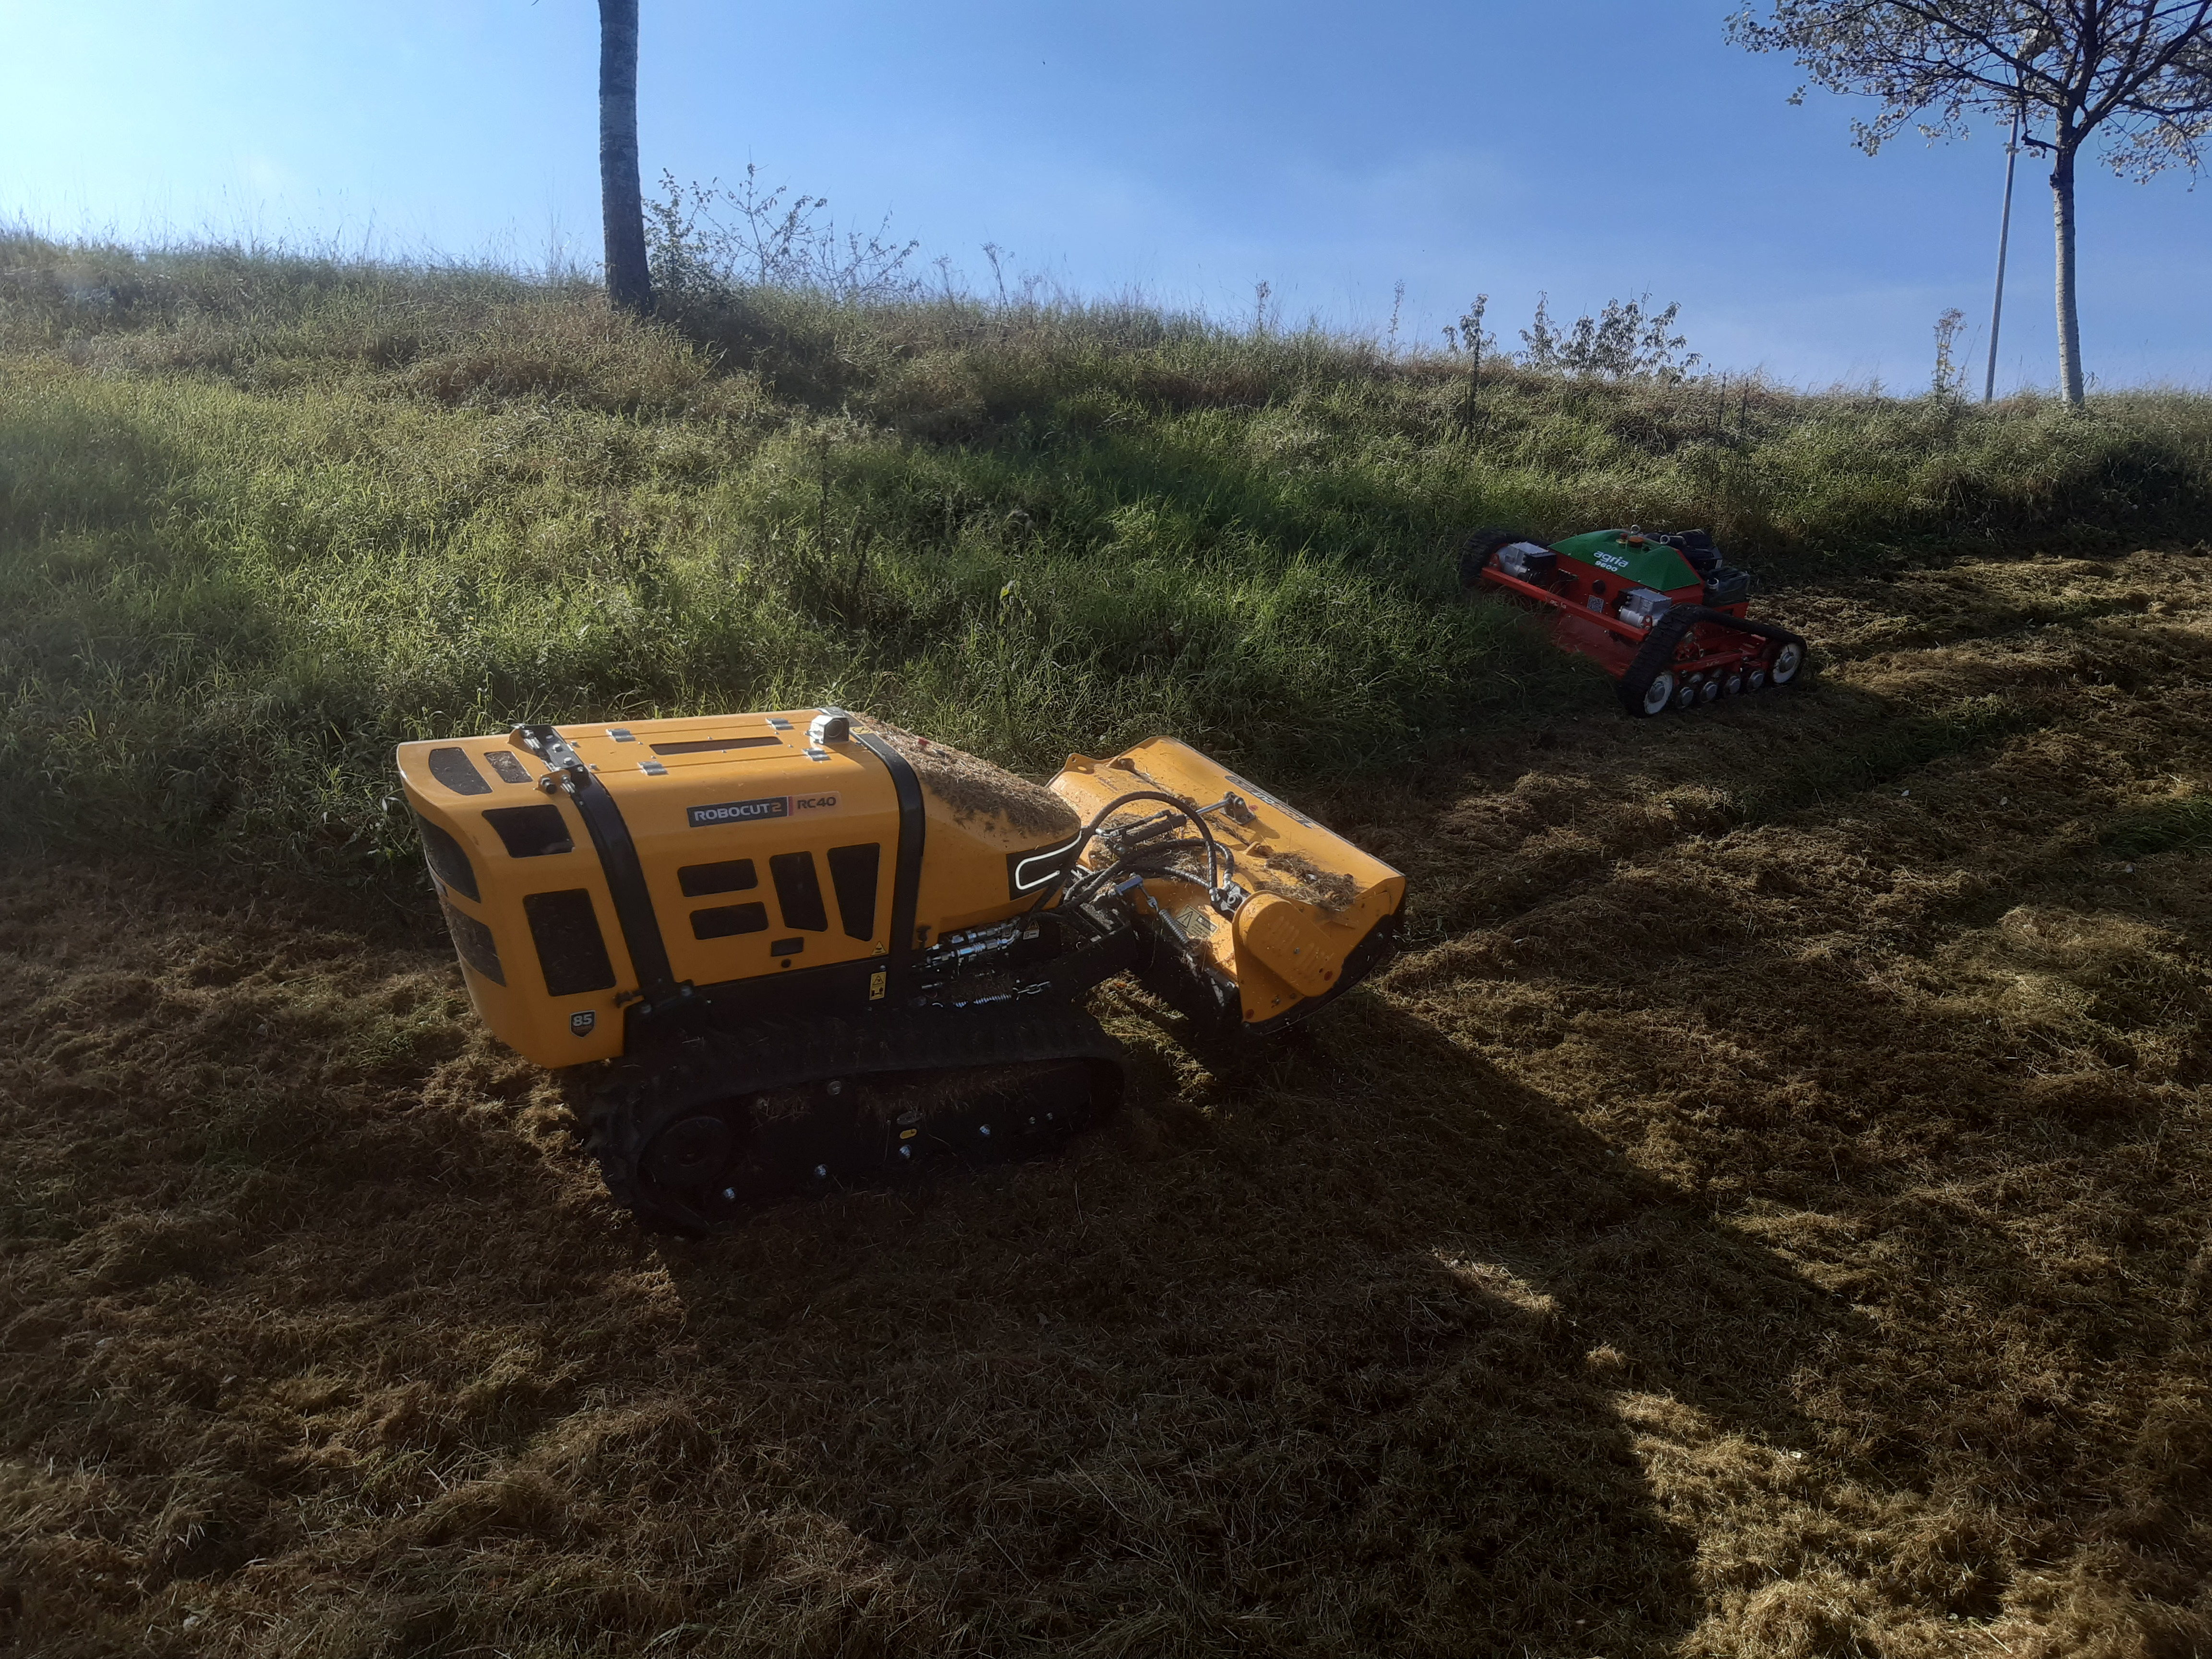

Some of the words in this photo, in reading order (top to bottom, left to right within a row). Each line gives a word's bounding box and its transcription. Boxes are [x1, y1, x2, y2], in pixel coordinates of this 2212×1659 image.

[1593, 551, 1629, 568] agria
[1595, 560, 1618, 572] 9600
[797, 796, 837, 809] RC40
[1251, 791, 1304, 821] ROBOCUT
[573, 1013, 592, 1026] 85
